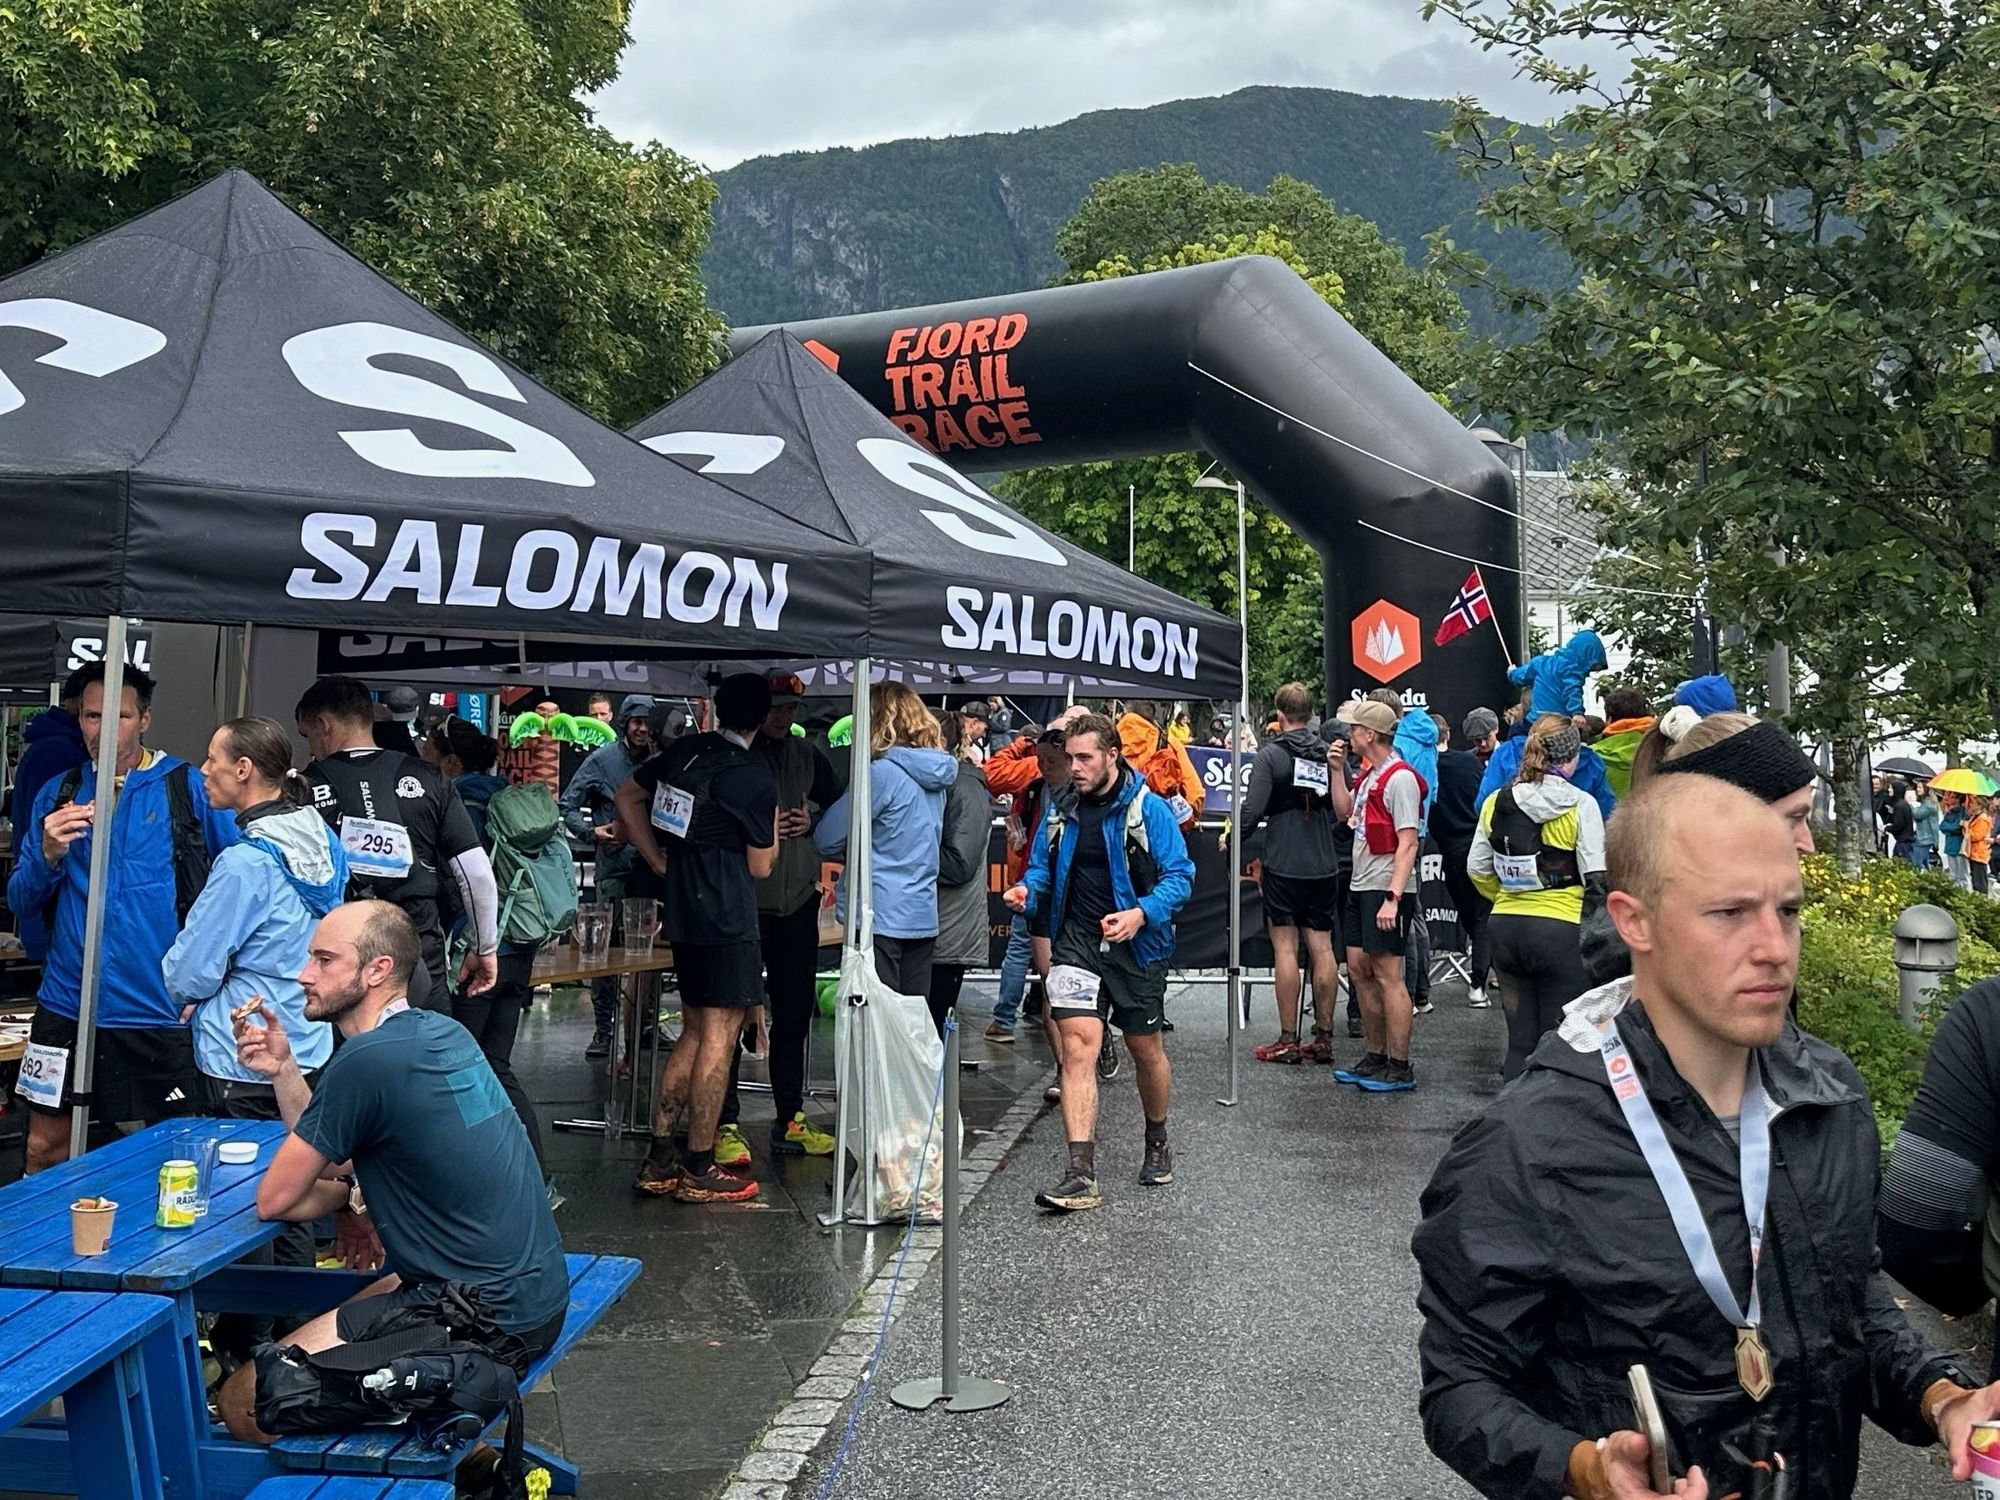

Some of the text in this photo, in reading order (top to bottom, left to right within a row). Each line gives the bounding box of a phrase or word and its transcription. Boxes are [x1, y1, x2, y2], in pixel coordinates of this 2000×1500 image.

[886, 313, 1028, 364] FJORD
[885, 353, 1026, 411] TRAIL
[889, 400, 1043, 452] RACE
[285, 512, 789, 632] SALOMON
[941, 585, 1198, 681] SALOMON
[361, 833, 394, 855] 295
[1058, 975, 1082, 991] 635
[21, 1054, 43, 1080] 262
[1603, 1035, 1622, 1054] 25K
